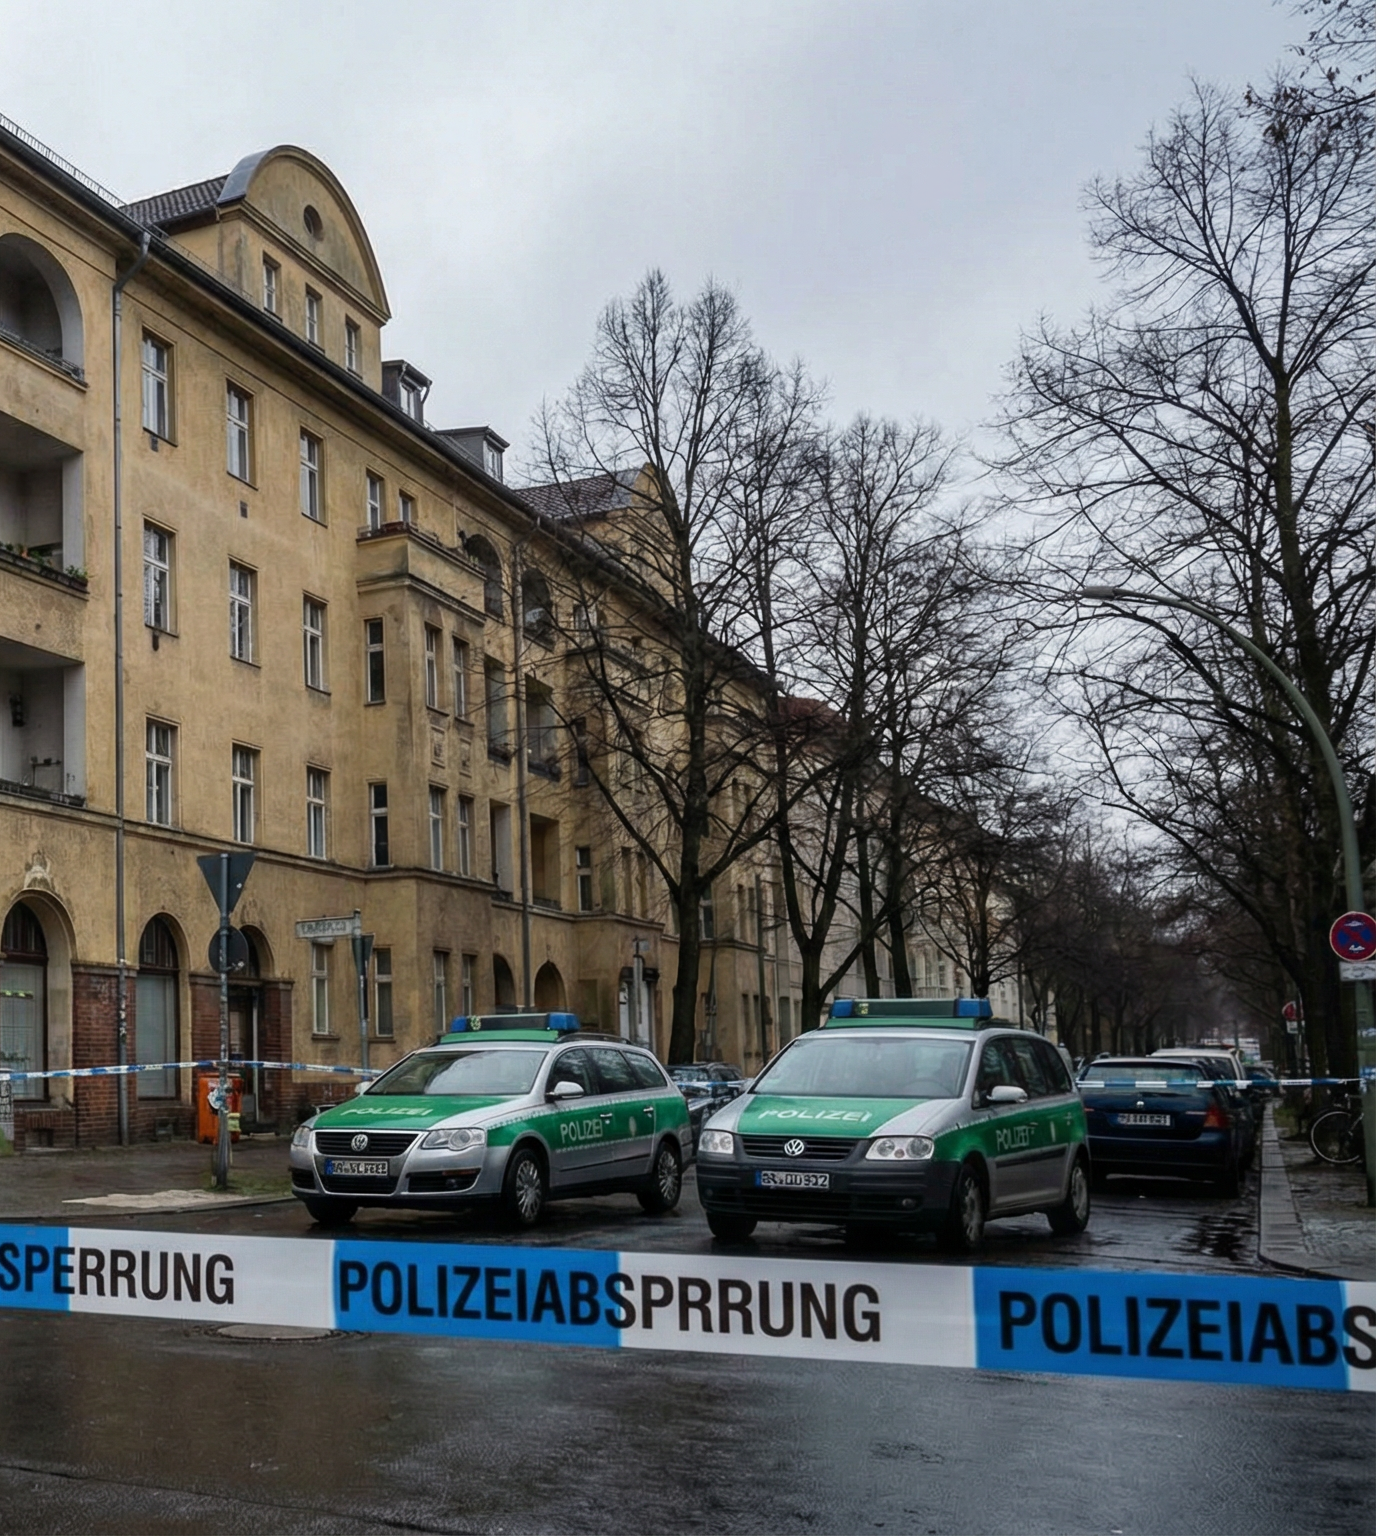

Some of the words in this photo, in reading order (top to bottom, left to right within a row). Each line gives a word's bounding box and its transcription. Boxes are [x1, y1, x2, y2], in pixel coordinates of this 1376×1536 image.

[758, 1109, 873, 1122] POLIZEI
[338, 1260, 882, 1343] POLIZEIABSPRRUNG
[998, 1290, 1376, 1370] POLIZEIABS
